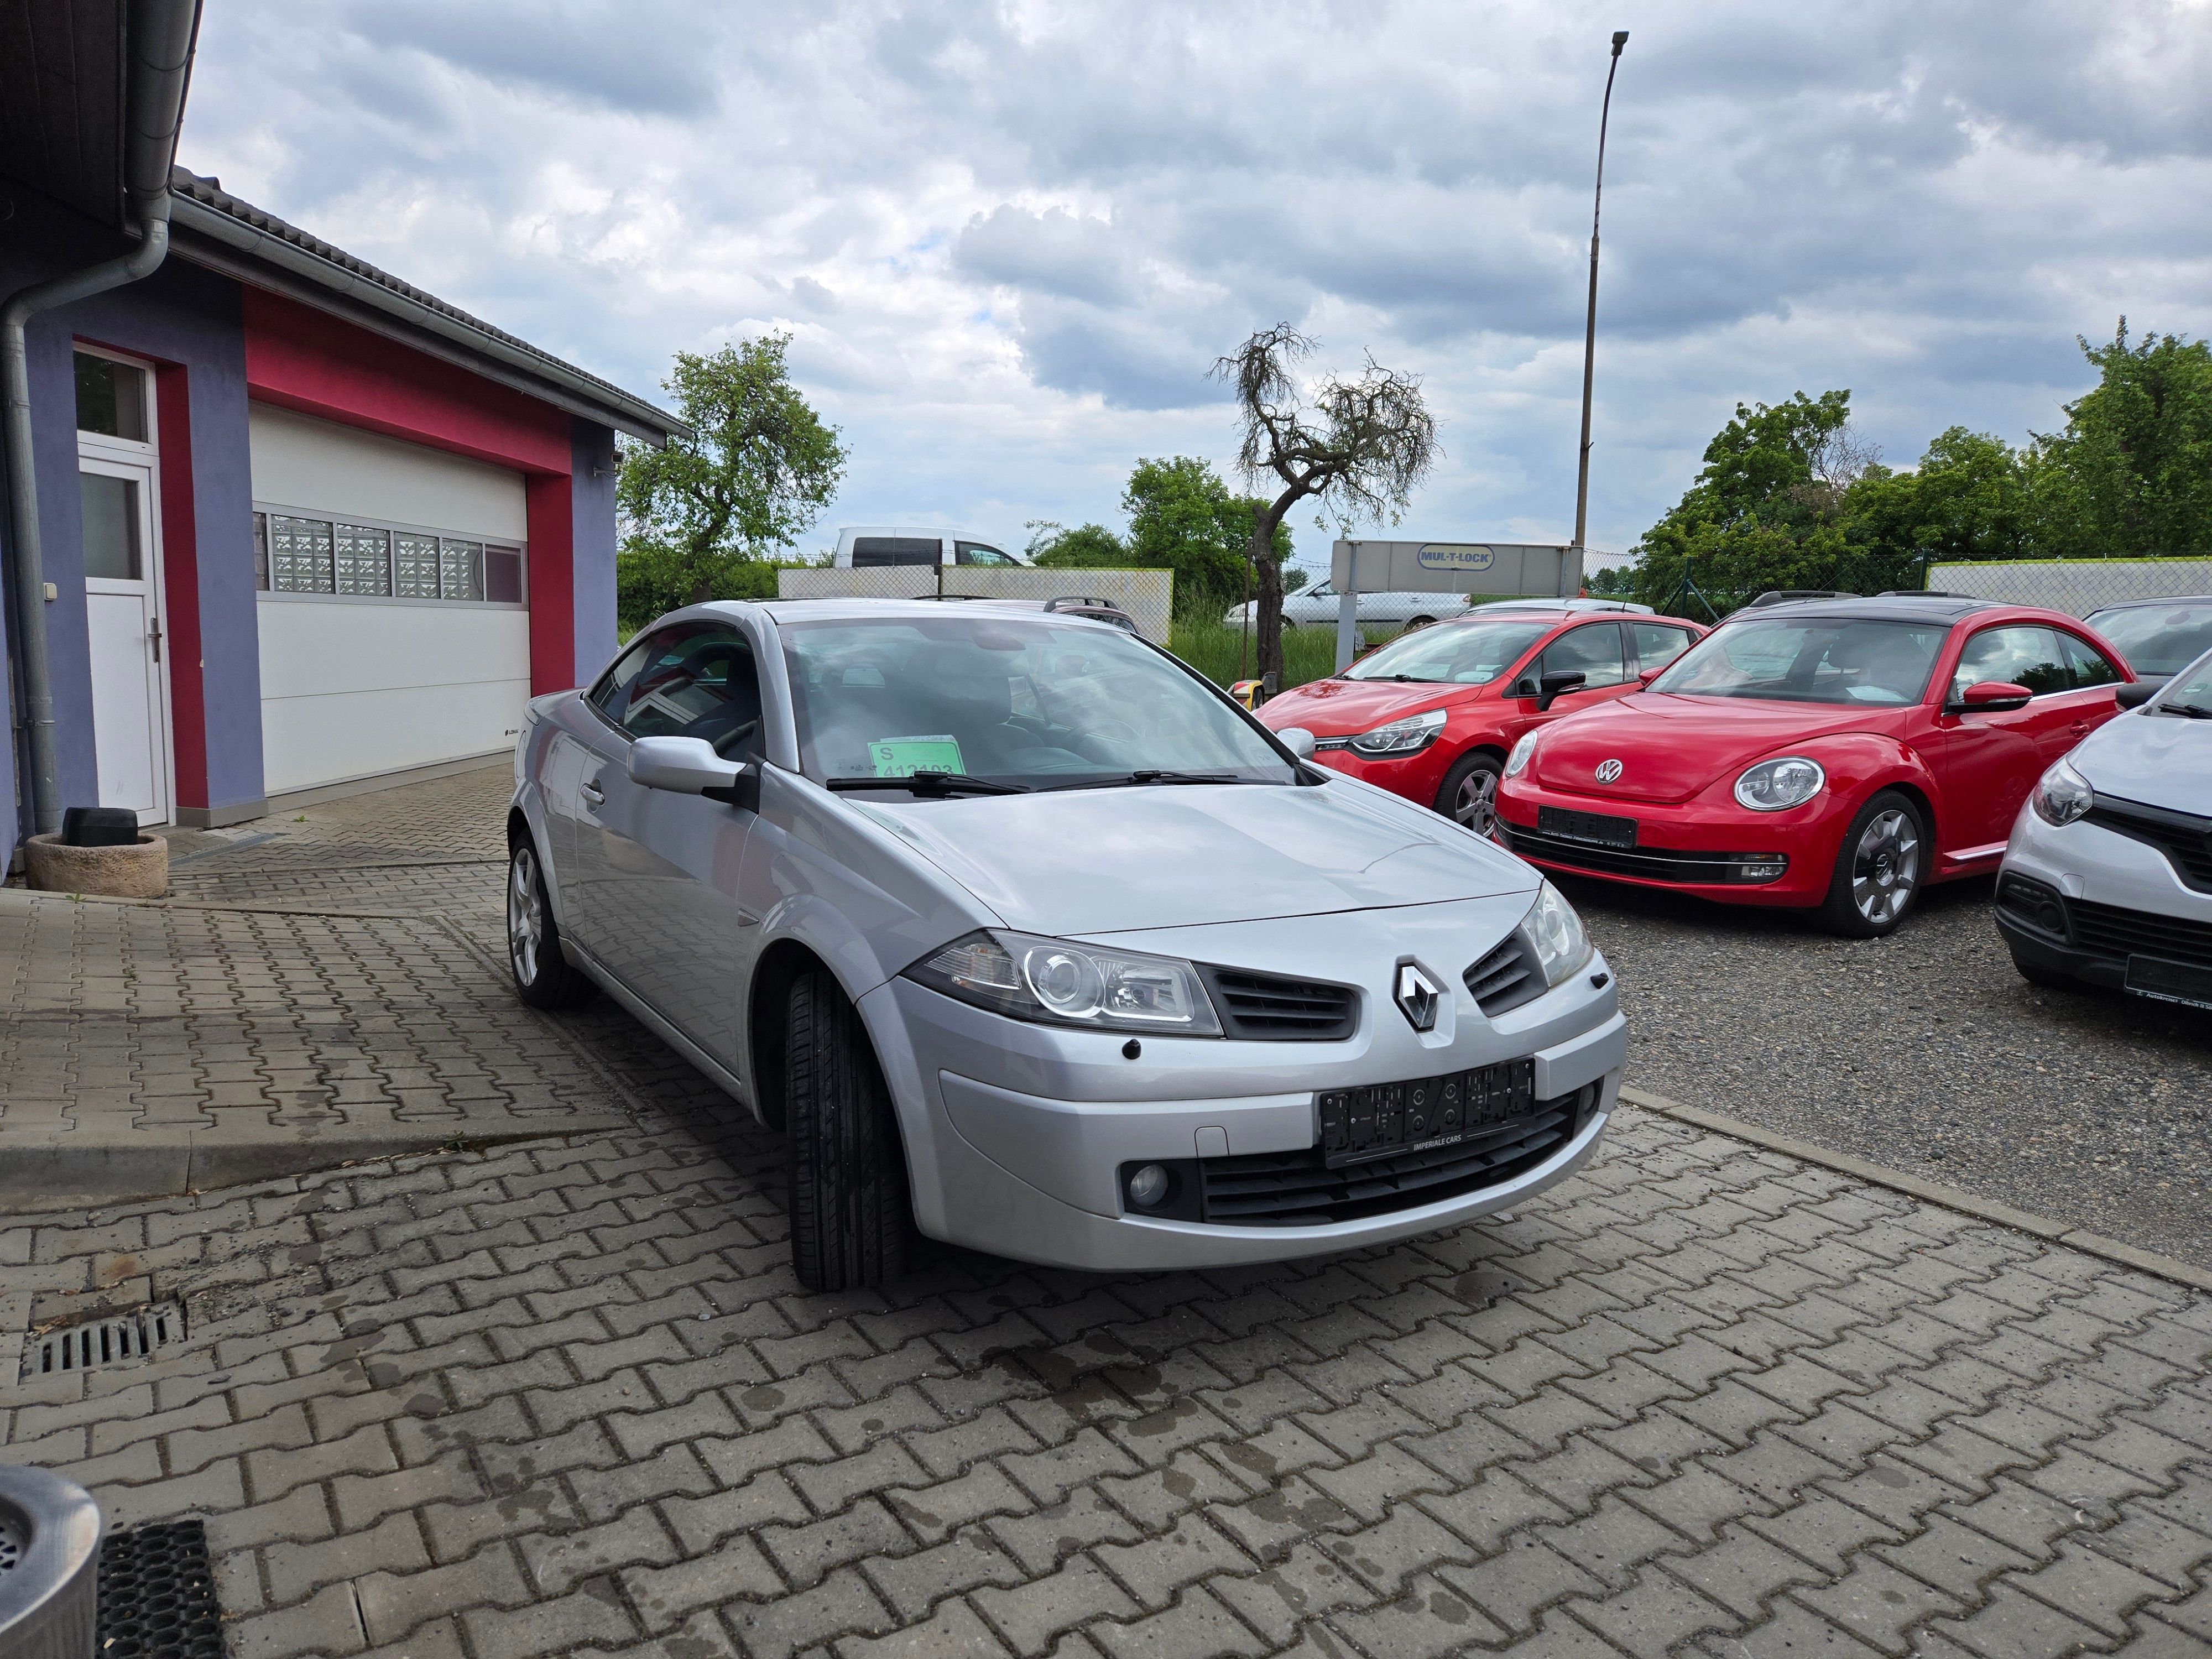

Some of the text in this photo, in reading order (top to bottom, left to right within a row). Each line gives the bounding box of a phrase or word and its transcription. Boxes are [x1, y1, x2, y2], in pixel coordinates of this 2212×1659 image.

[1421, 552, 1489, 563] MUL-T-LOCK
[880, 747, 894, 760] S
[1413, 1135, 1461, 1151] IMPERIALE CARS
